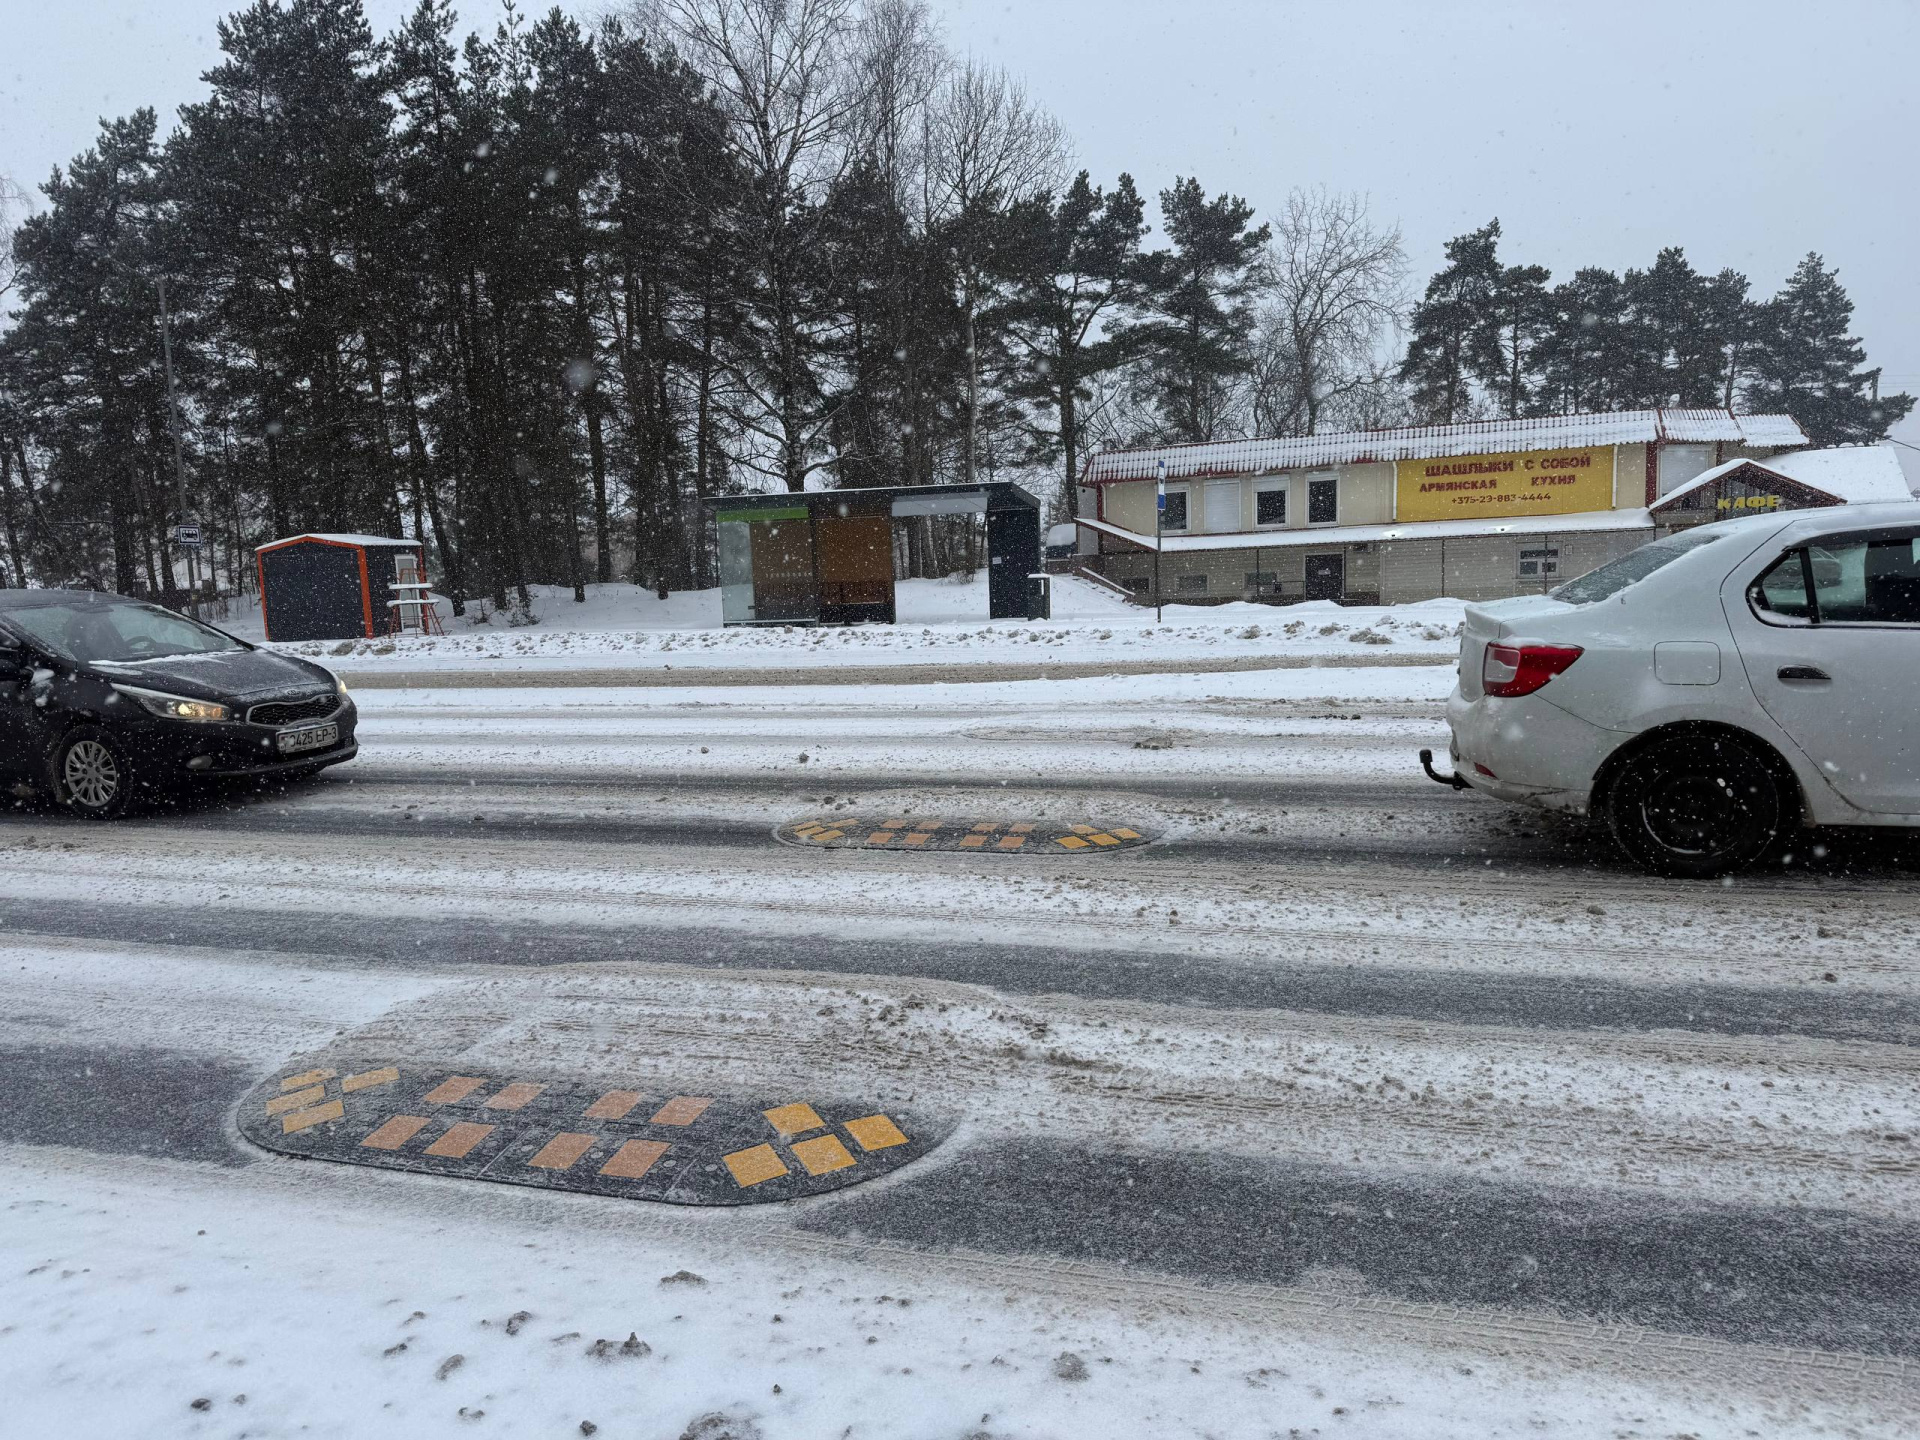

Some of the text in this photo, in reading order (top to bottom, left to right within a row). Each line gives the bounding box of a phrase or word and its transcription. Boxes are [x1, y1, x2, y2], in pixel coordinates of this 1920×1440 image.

[1425, 453, 1591, 477] ШАШЛЫКИ С СОБОЙ
[1419, 474, 1576, 493] АРМЯНСКАЯ КУХНЯ
[1451, 492, 1552, 505] +375-29-883-4444
[1717, 494, 1780, 510] КАФЕ
